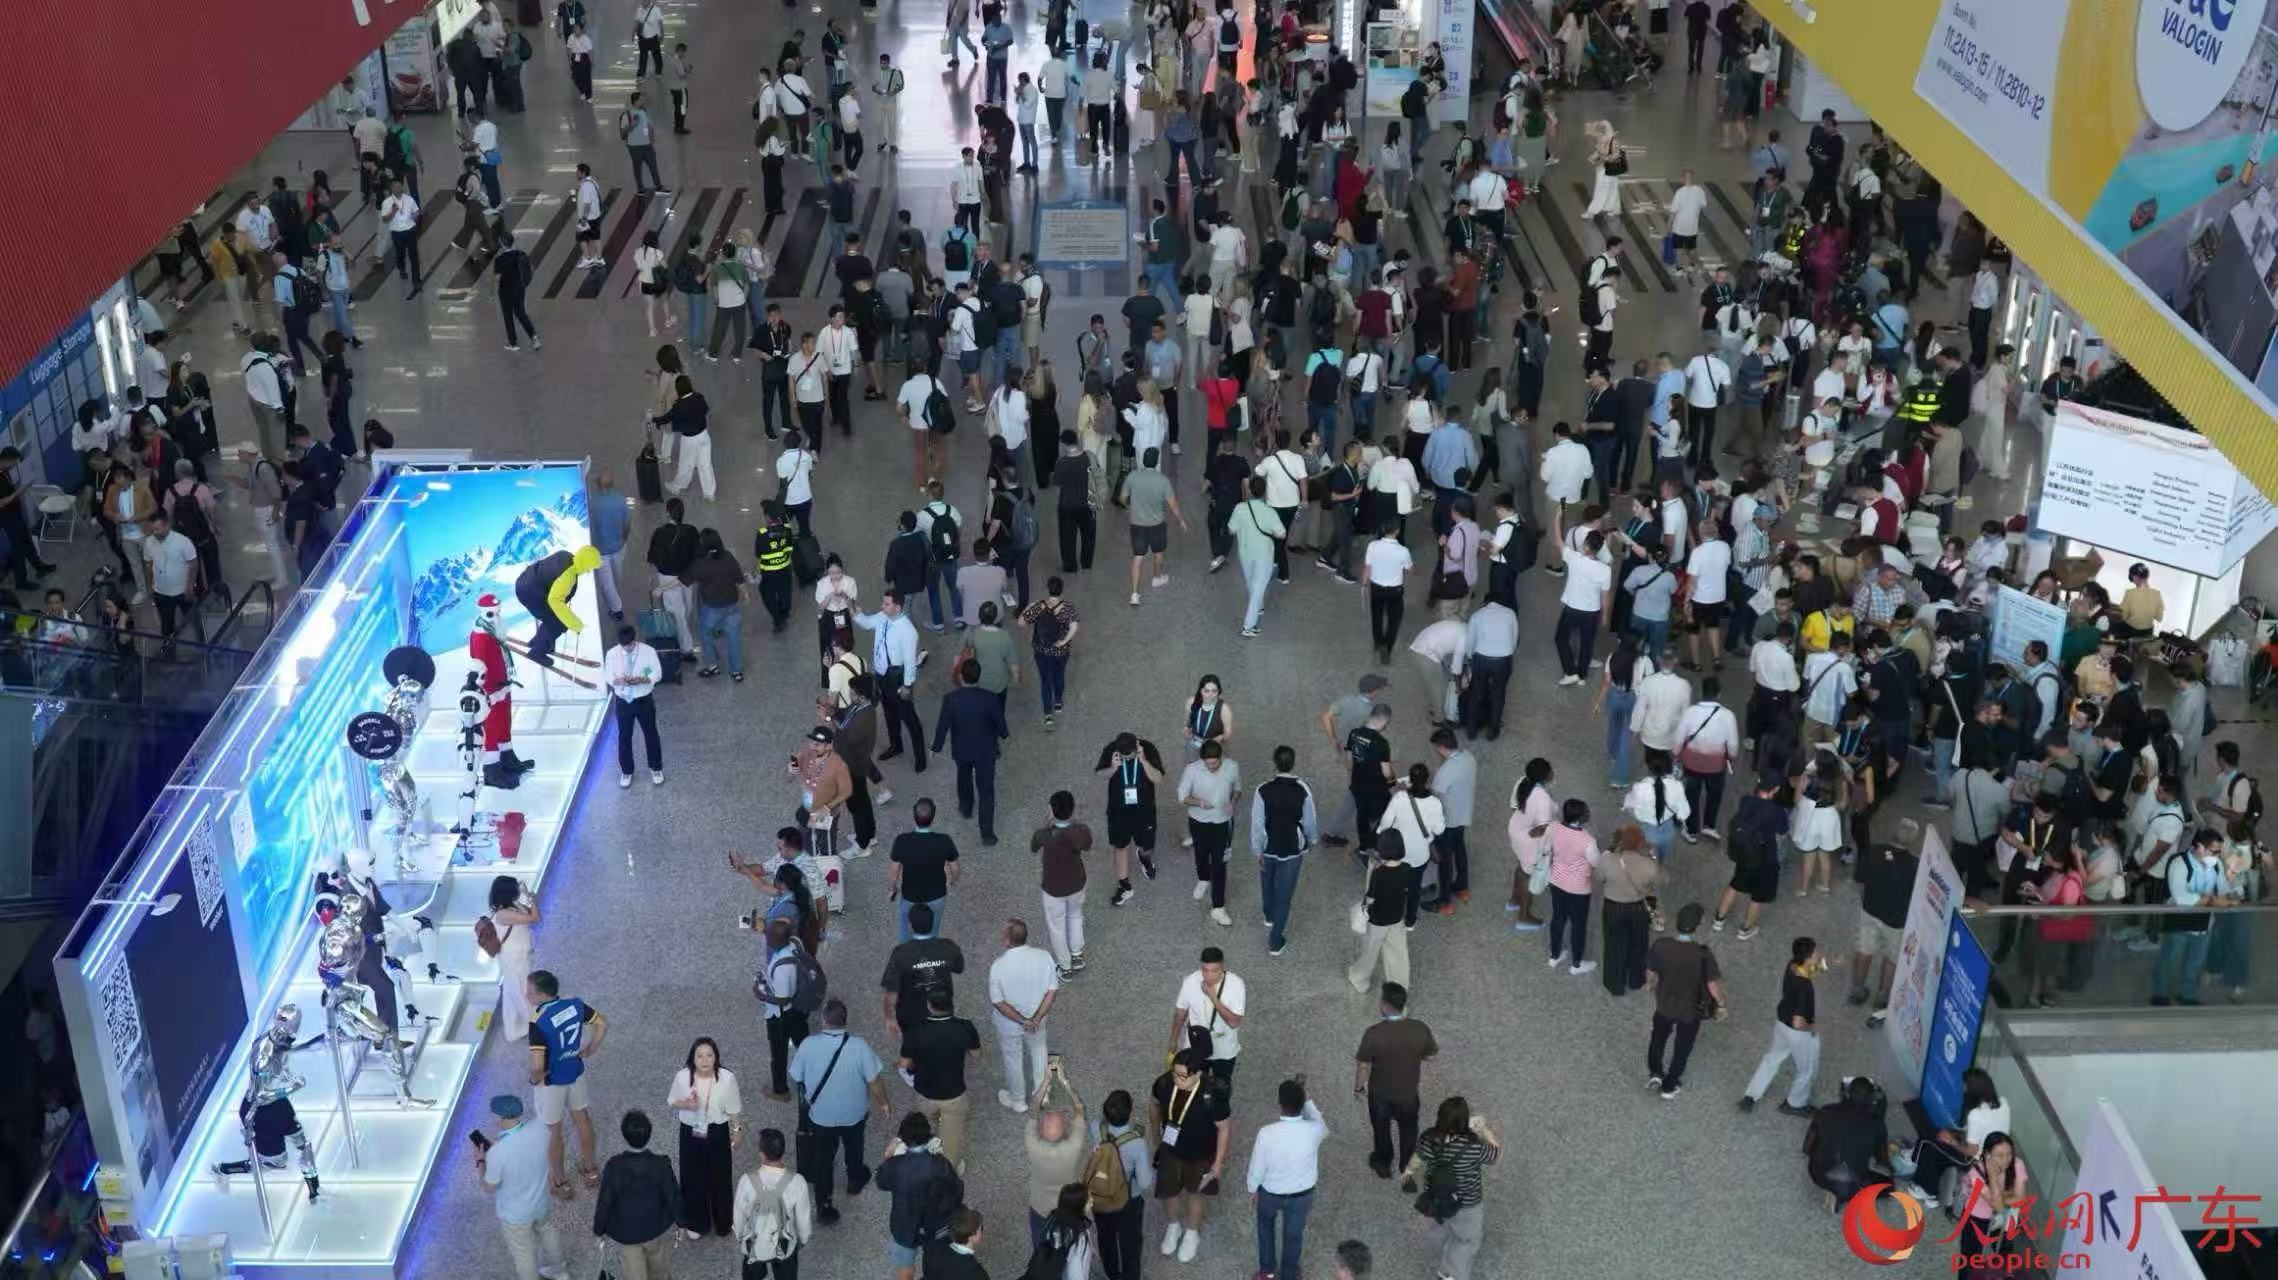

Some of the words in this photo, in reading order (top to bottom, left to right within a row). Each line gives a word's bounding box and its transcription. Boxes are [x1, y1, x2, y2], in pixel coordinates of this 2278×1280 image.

[2162, 7, 2223, 65] VALOGIN
[1944, 25, 1990, 76] 11.2A13-15
[1994, 65, 2045, 120] 11.2B10-12
[29, 348, 63, 385] Luggage
[560, 1021, 580, 1049] 17
